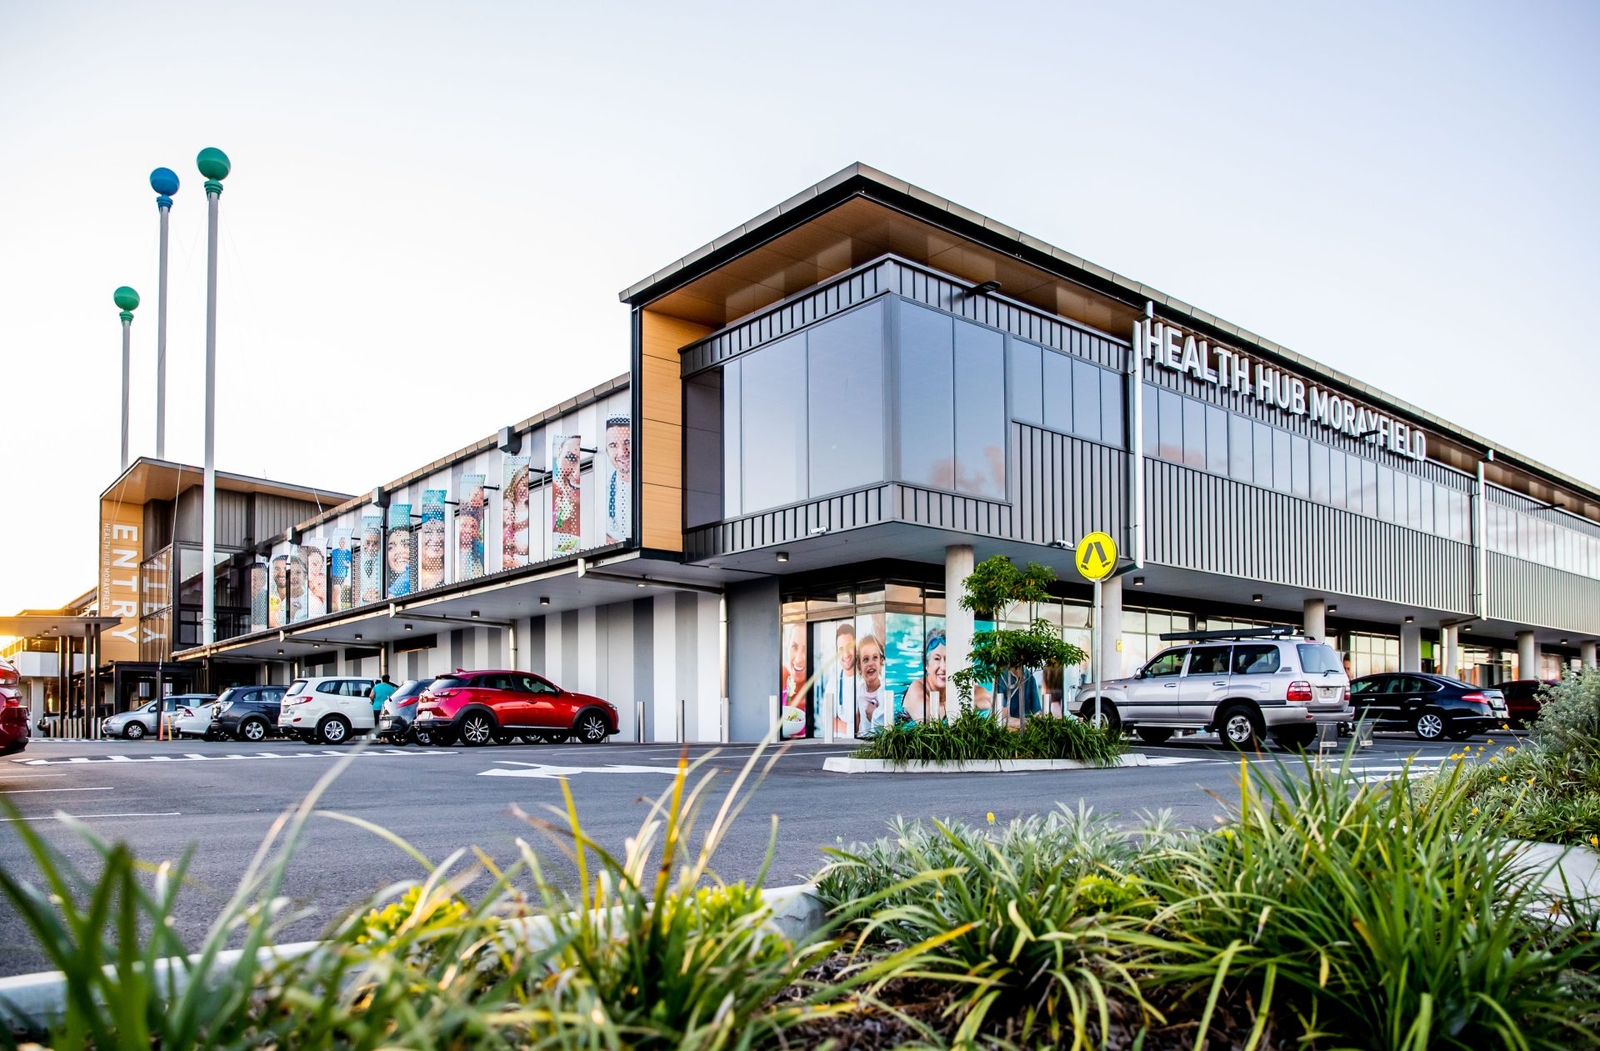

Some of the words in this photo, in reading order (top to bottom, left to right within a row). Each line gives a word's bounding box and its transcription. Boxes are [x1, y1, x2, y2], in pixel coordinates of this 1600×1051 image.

[1142, 318, 1250, 396] HEALTH
[1255, 363, 1306, 415] HUB
[1309, 386, 1427, 462] MORAYFIELD
[103, 568, 111, 610] MORAYFIELD
[112, 524, 139, 643] ENTRY
